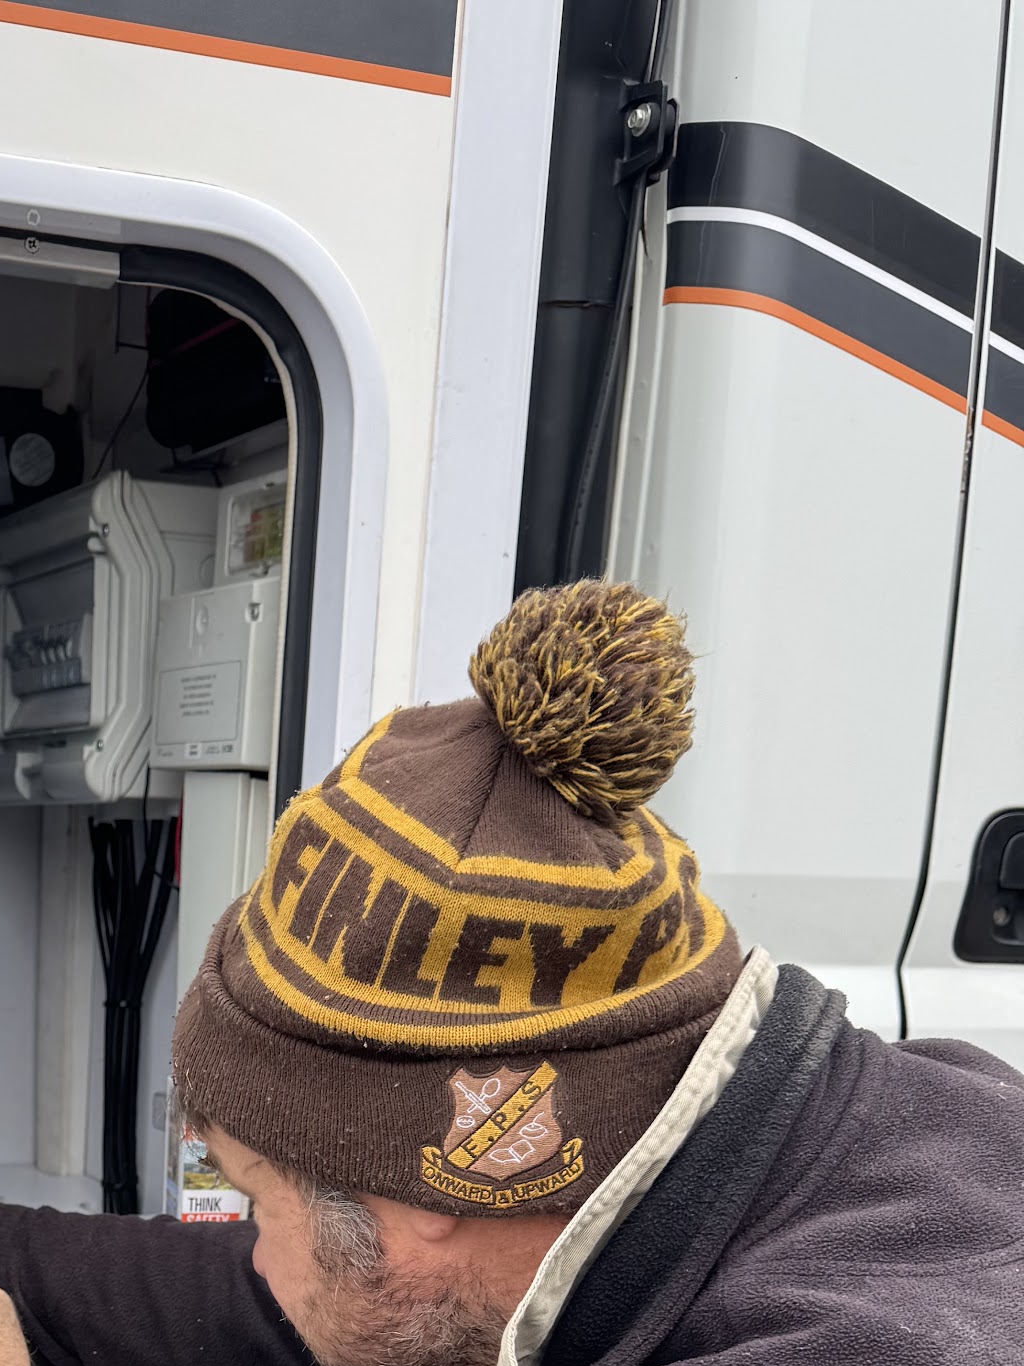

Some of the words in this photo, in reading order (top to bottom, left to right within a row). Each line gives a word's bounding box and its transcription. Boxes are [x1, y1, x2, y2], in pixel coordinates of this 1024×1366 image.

[272, 812, 616, 1006] FINLEY
[423, 1166, 493, 1201] ONWARD
[515, 1163, 581, 1199] UPWARD
[187, 1196, 222, 1212] THINK
